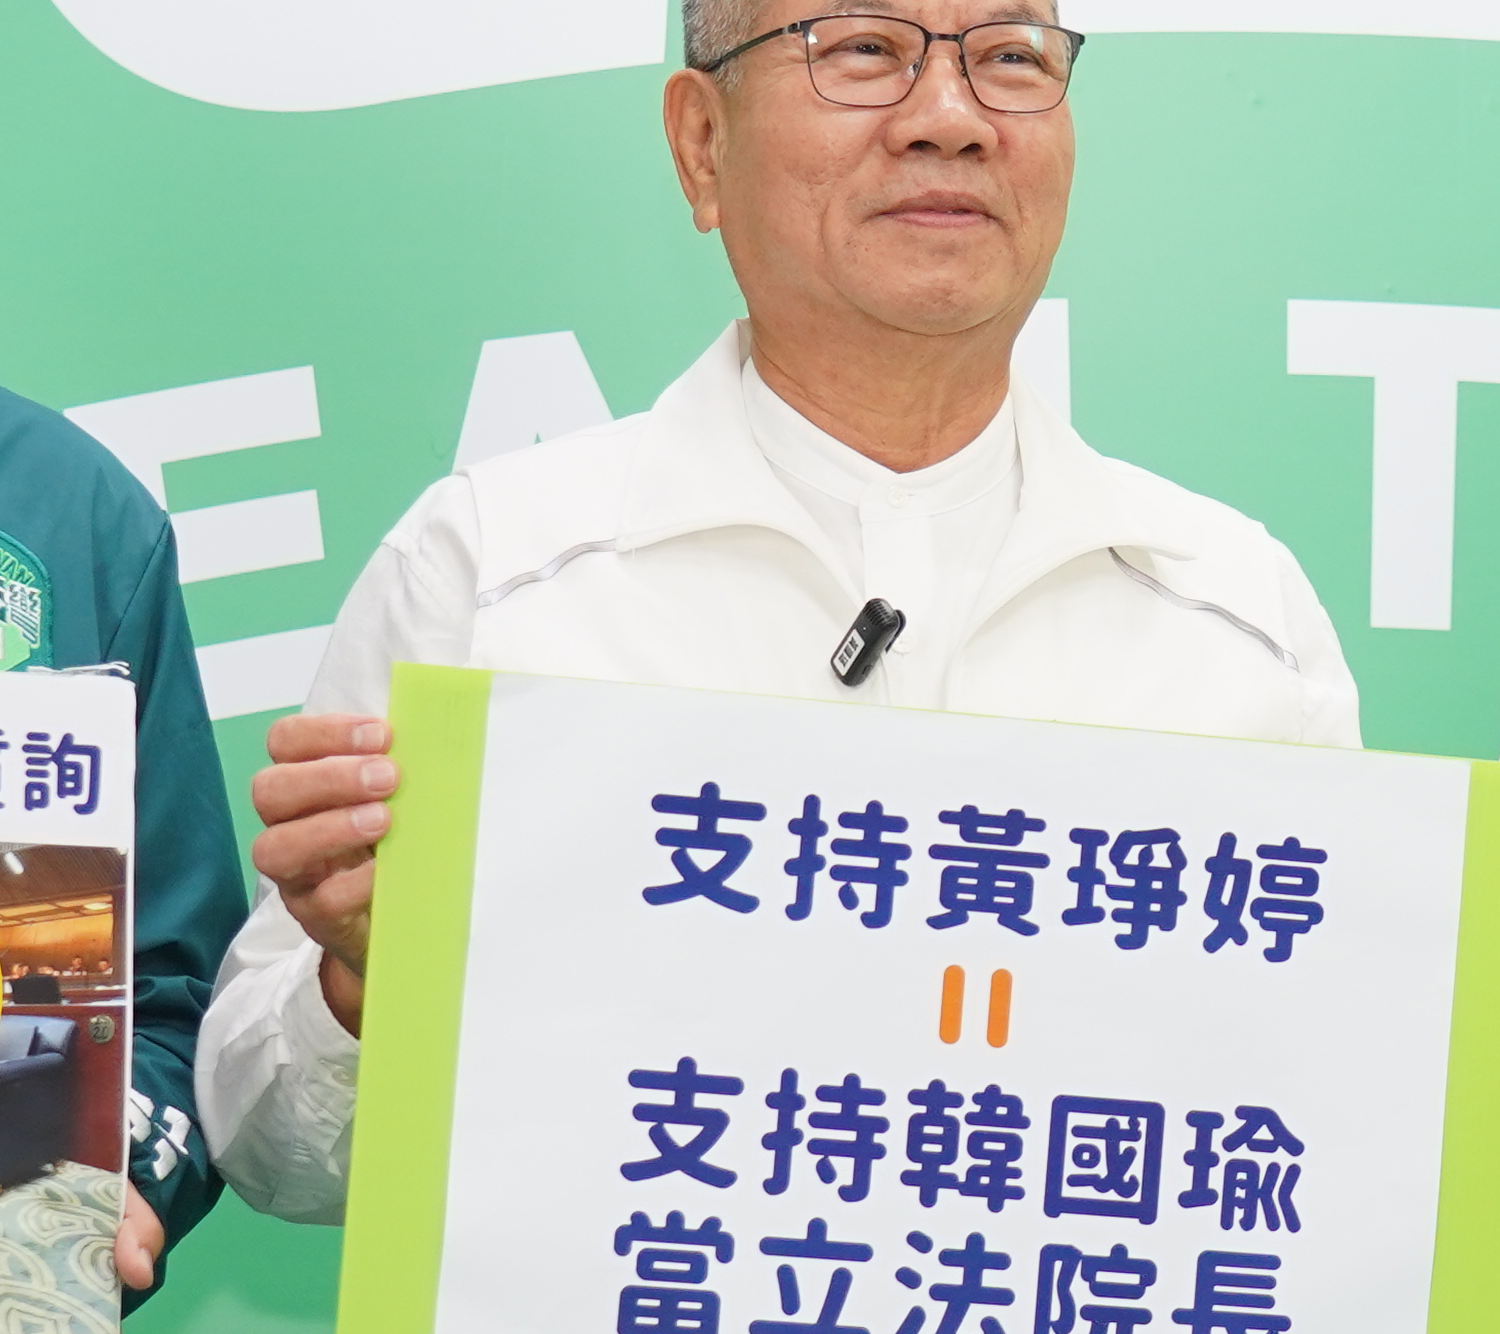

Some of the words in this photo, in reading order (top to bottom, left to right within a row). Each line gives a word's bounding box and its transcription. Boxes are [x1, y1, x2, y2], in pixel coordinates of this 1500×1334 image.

[641, 781, 1328, 963] 支持黃琤婷
[619, 1056, 1306, 1235] 支持韓國瑜
